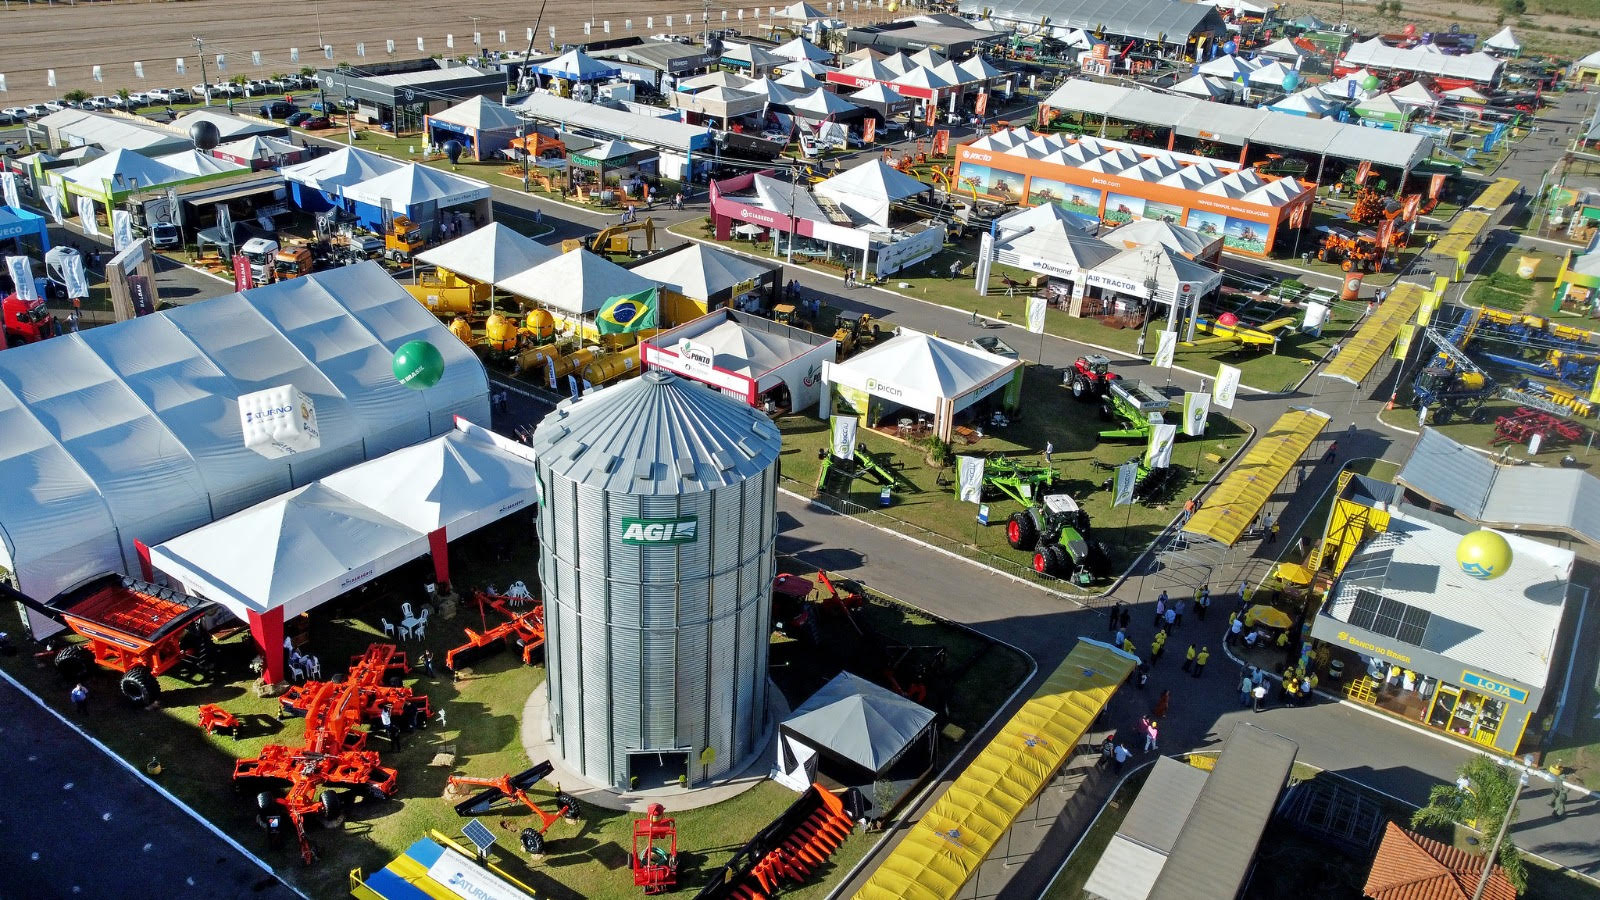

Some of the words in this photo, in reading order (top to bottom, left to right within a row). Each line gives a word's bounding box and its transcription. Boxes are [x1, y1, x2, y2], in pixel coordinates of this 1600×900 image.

[571, 154, 599, 168] Koppert
[969, 152, 992, 162] jacto
[1091, 176, 1121, 188] jacto.com
[1041, 262, 1072, 276] Diamond
[1088, 274, 1100, 283] AIR
[1101, 277, 1136, 291] TRACTOR
[691, 353, 711, 365] PONTO
[877, 383, 903, 398] piccin
[622, 523, 674, 541] AGI
[1348, 637, 1375, 651] BANCO
[1386, 649, 1411, 664] BRASIL
[1477, 678, 1511, 697] LOJA
